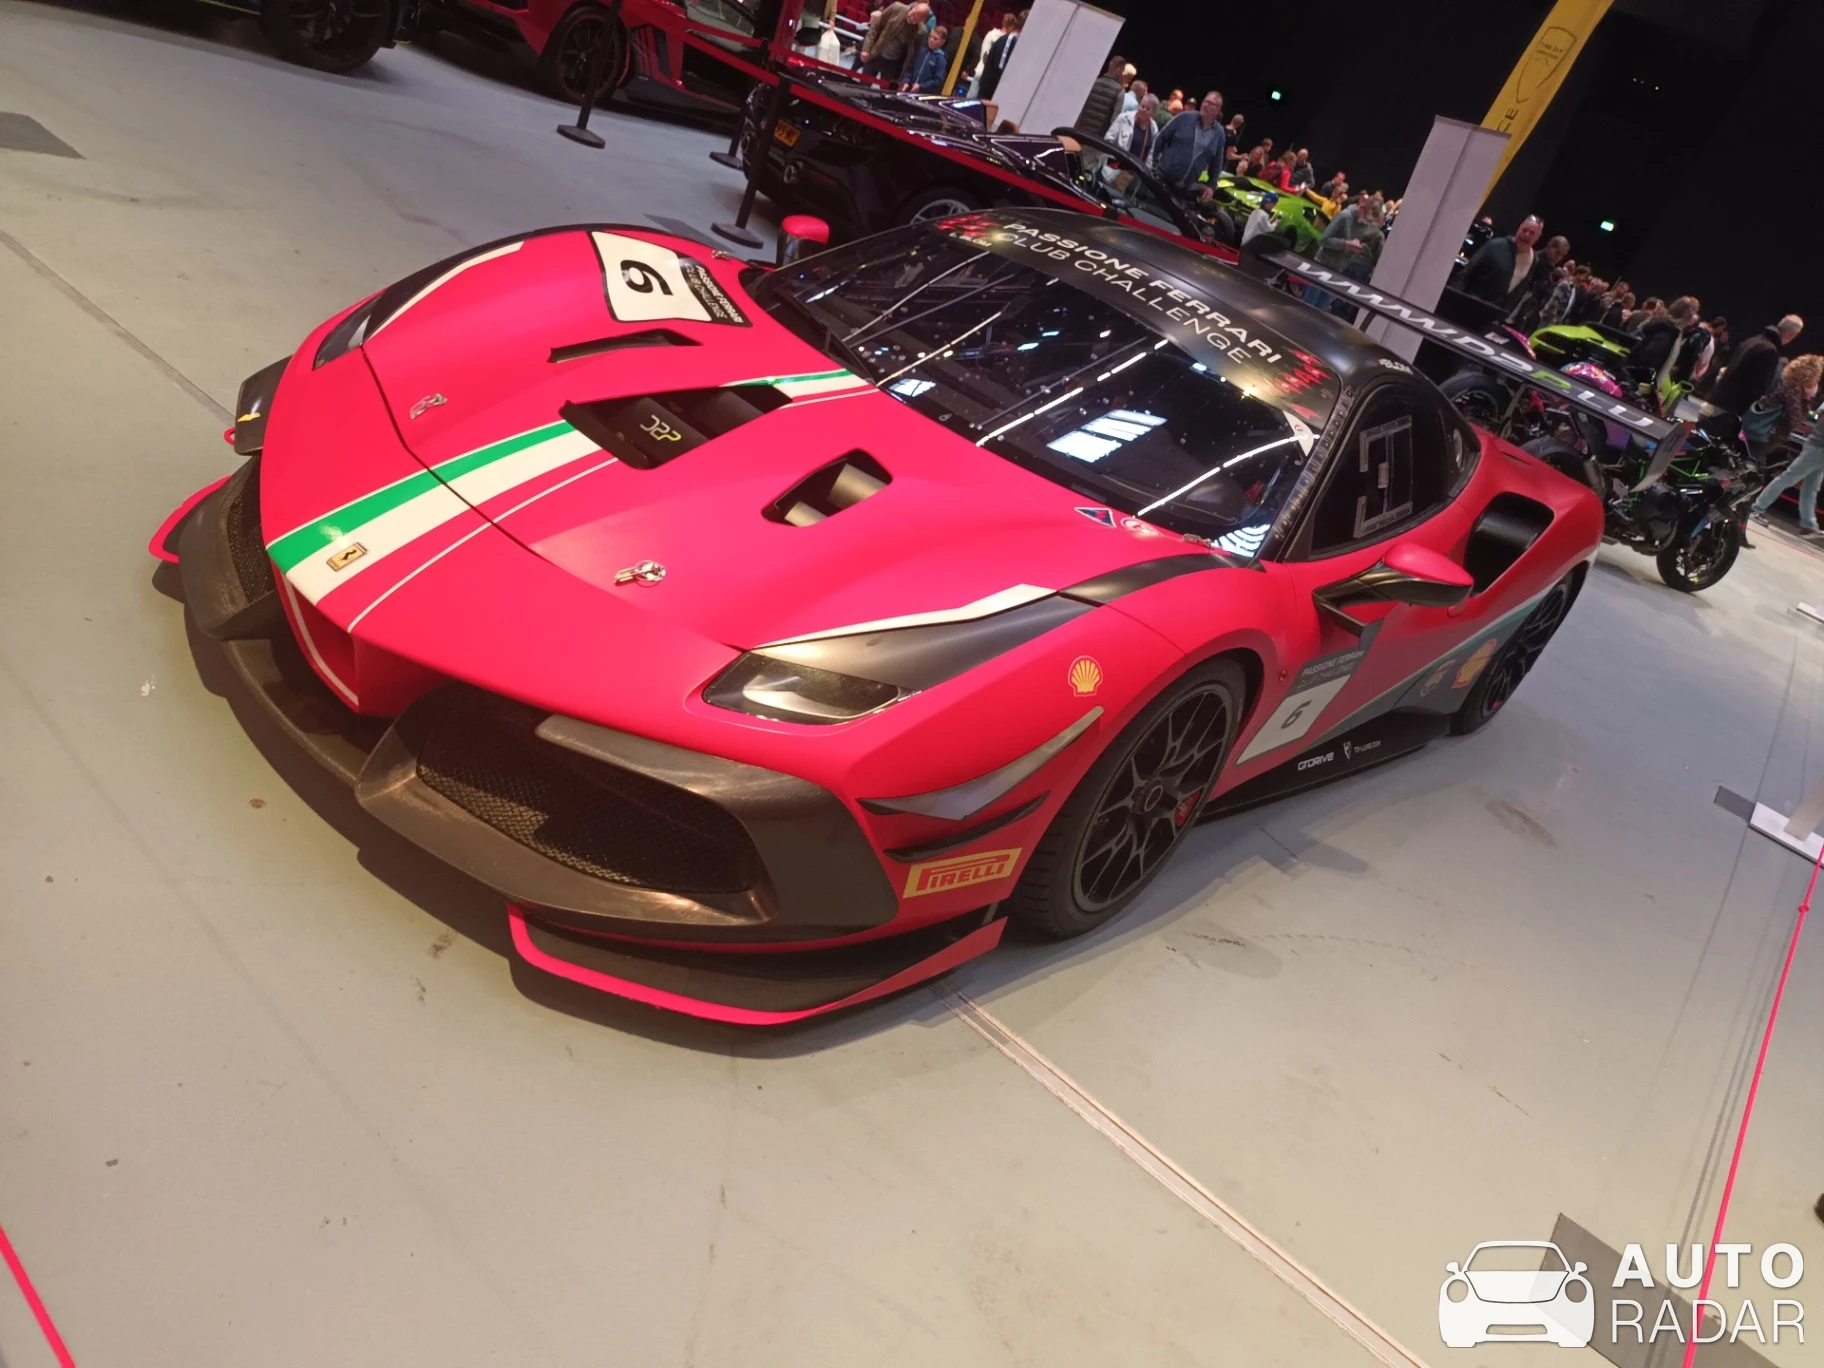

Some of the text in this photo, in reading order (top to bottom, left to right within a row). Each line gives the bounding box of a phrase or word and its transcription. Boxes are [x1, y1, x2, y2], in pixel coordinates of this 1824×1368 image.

[997, 232, 1252, 364] CLUB CHALLENGE
[1003, 223, 1282, 363] PASSIONE FERRARI
[1281, 700, 1313, 730] 6
[916, 854, 1011, 892] PIRELLI
